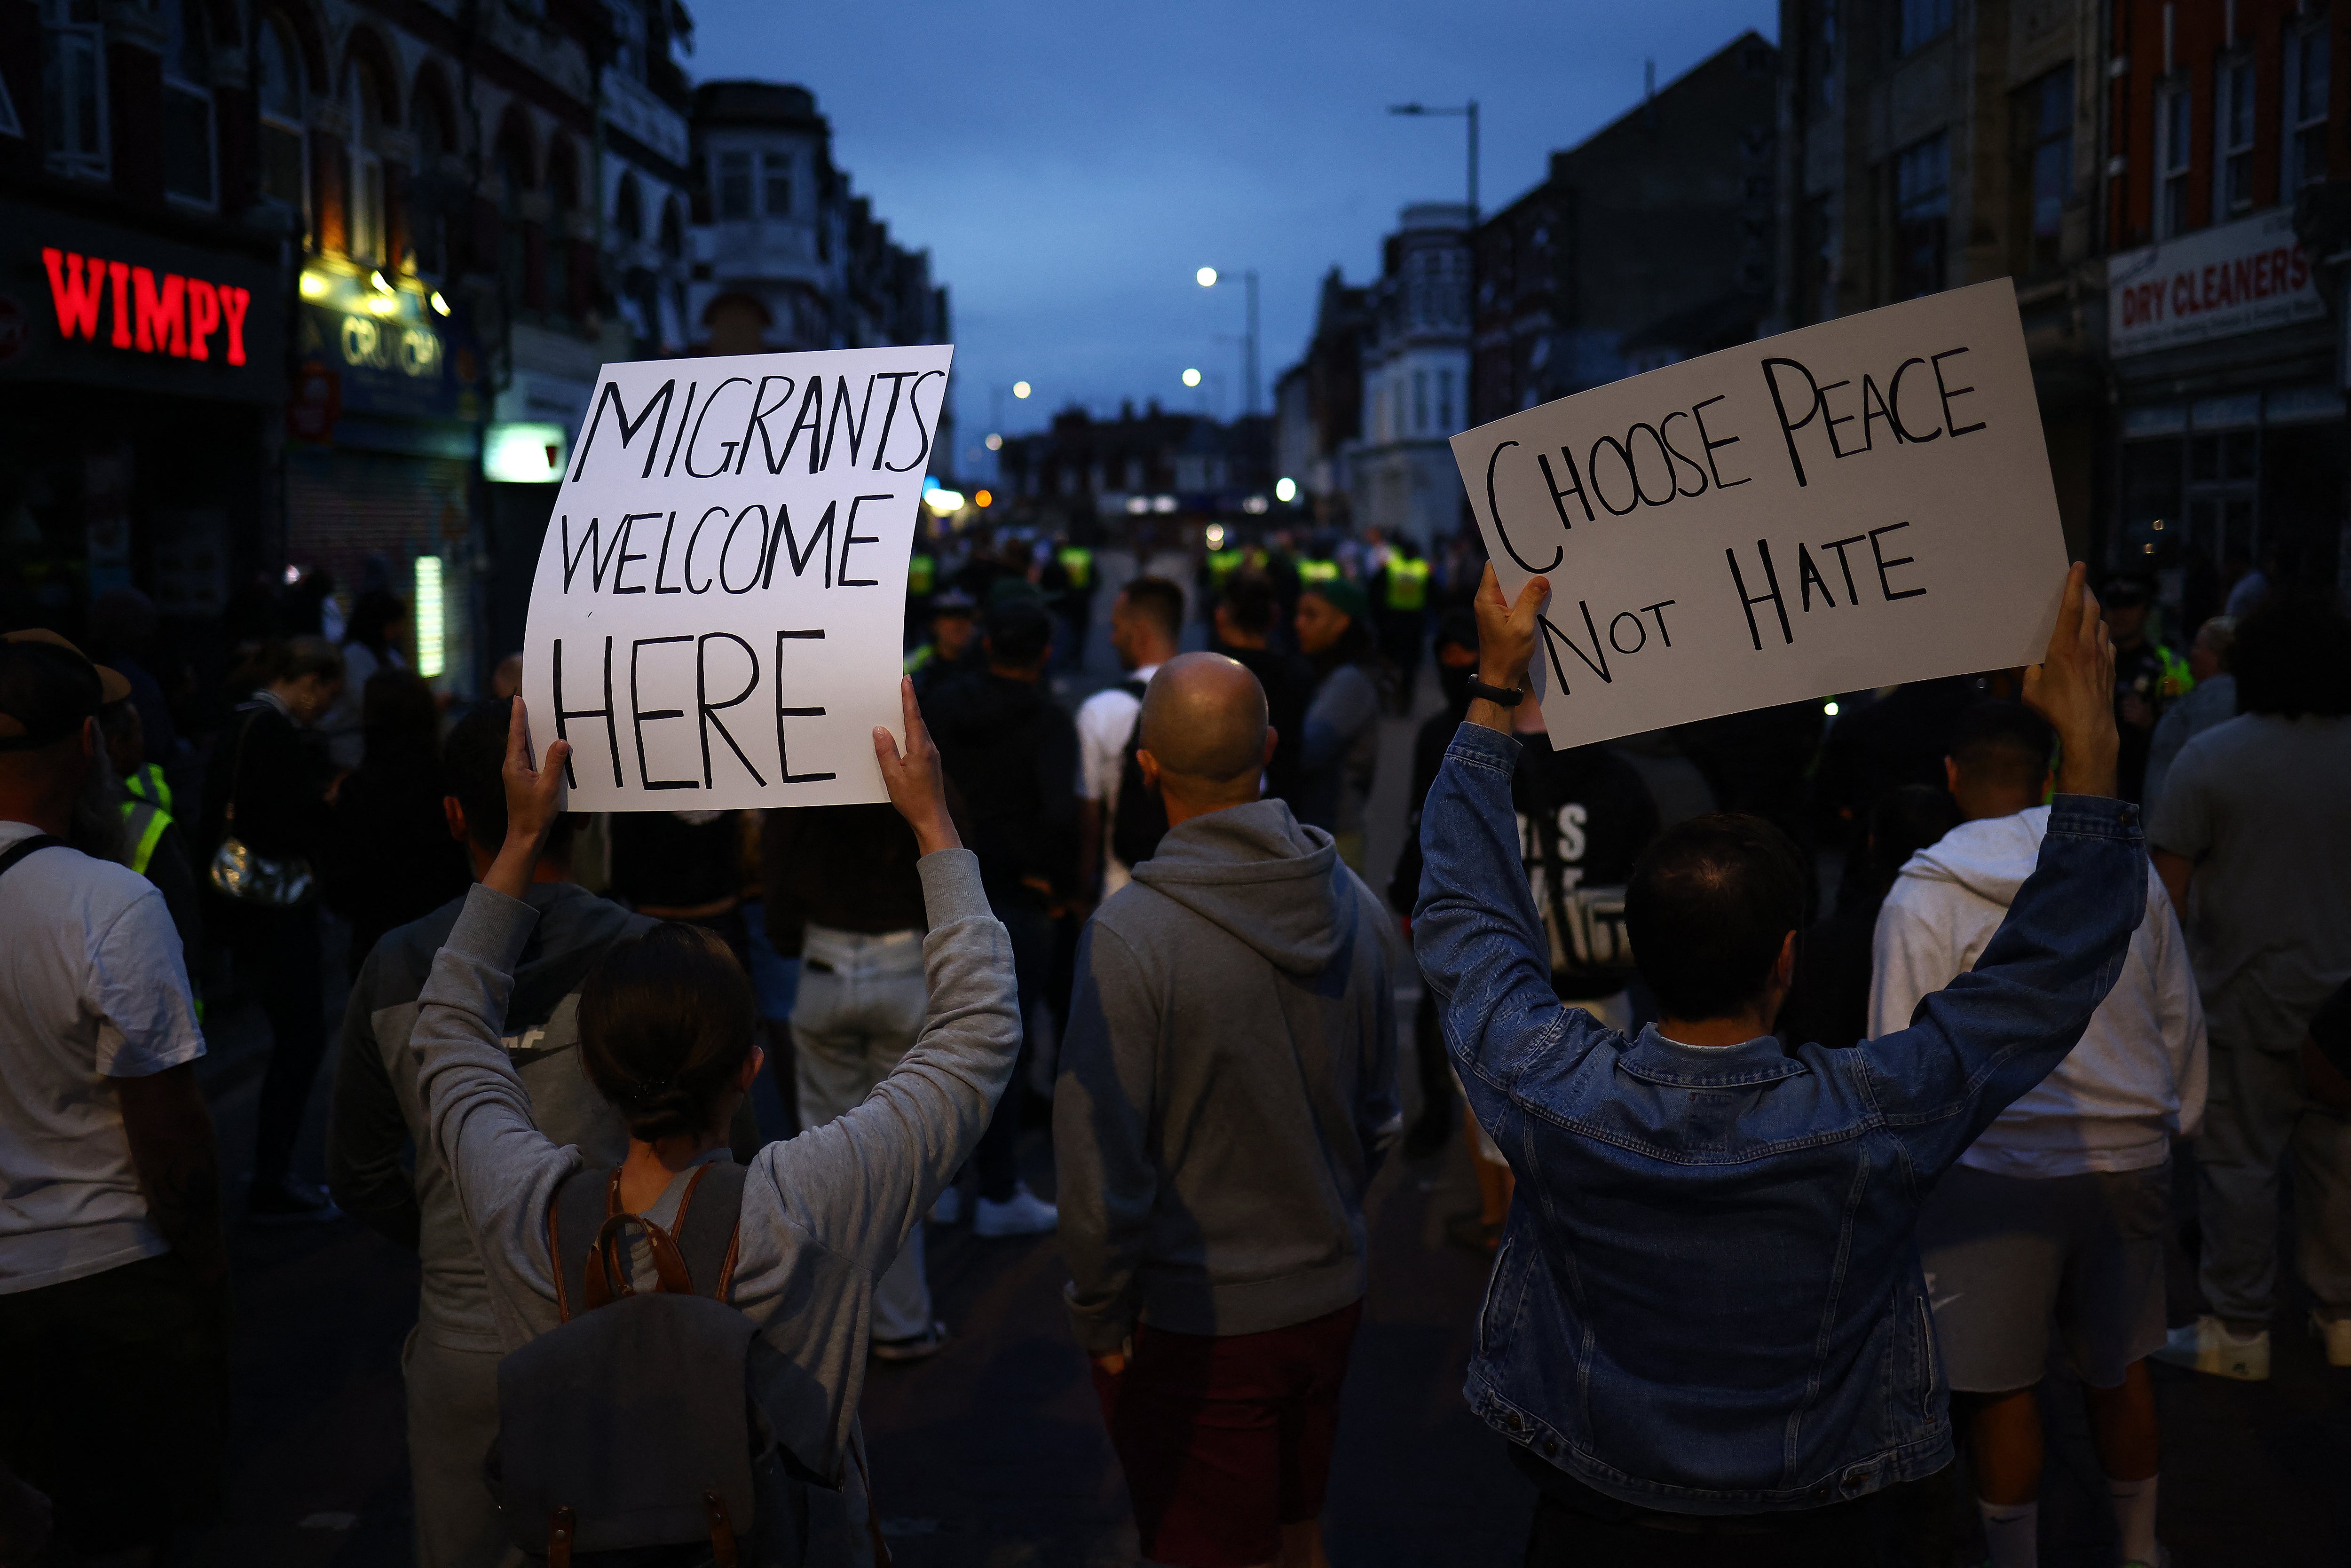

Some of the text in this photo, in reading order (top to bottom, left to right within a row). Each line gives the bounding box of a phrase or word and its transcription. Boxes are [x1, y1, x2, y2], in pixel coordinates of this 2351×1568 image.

[42, 246, 251, 367] WIMPY
[2122, 244, 2309, 326] DRY CLEANERS
[572, 370, 946, 482] MIGRANTS
[1487, 346, 1987, 574] CHOOSE PEACE
[562, 495, 894, 594] WELCOME
[1537, 521, 1927, 695] NOT HATE
[553, 630, 836, 790] HERE
